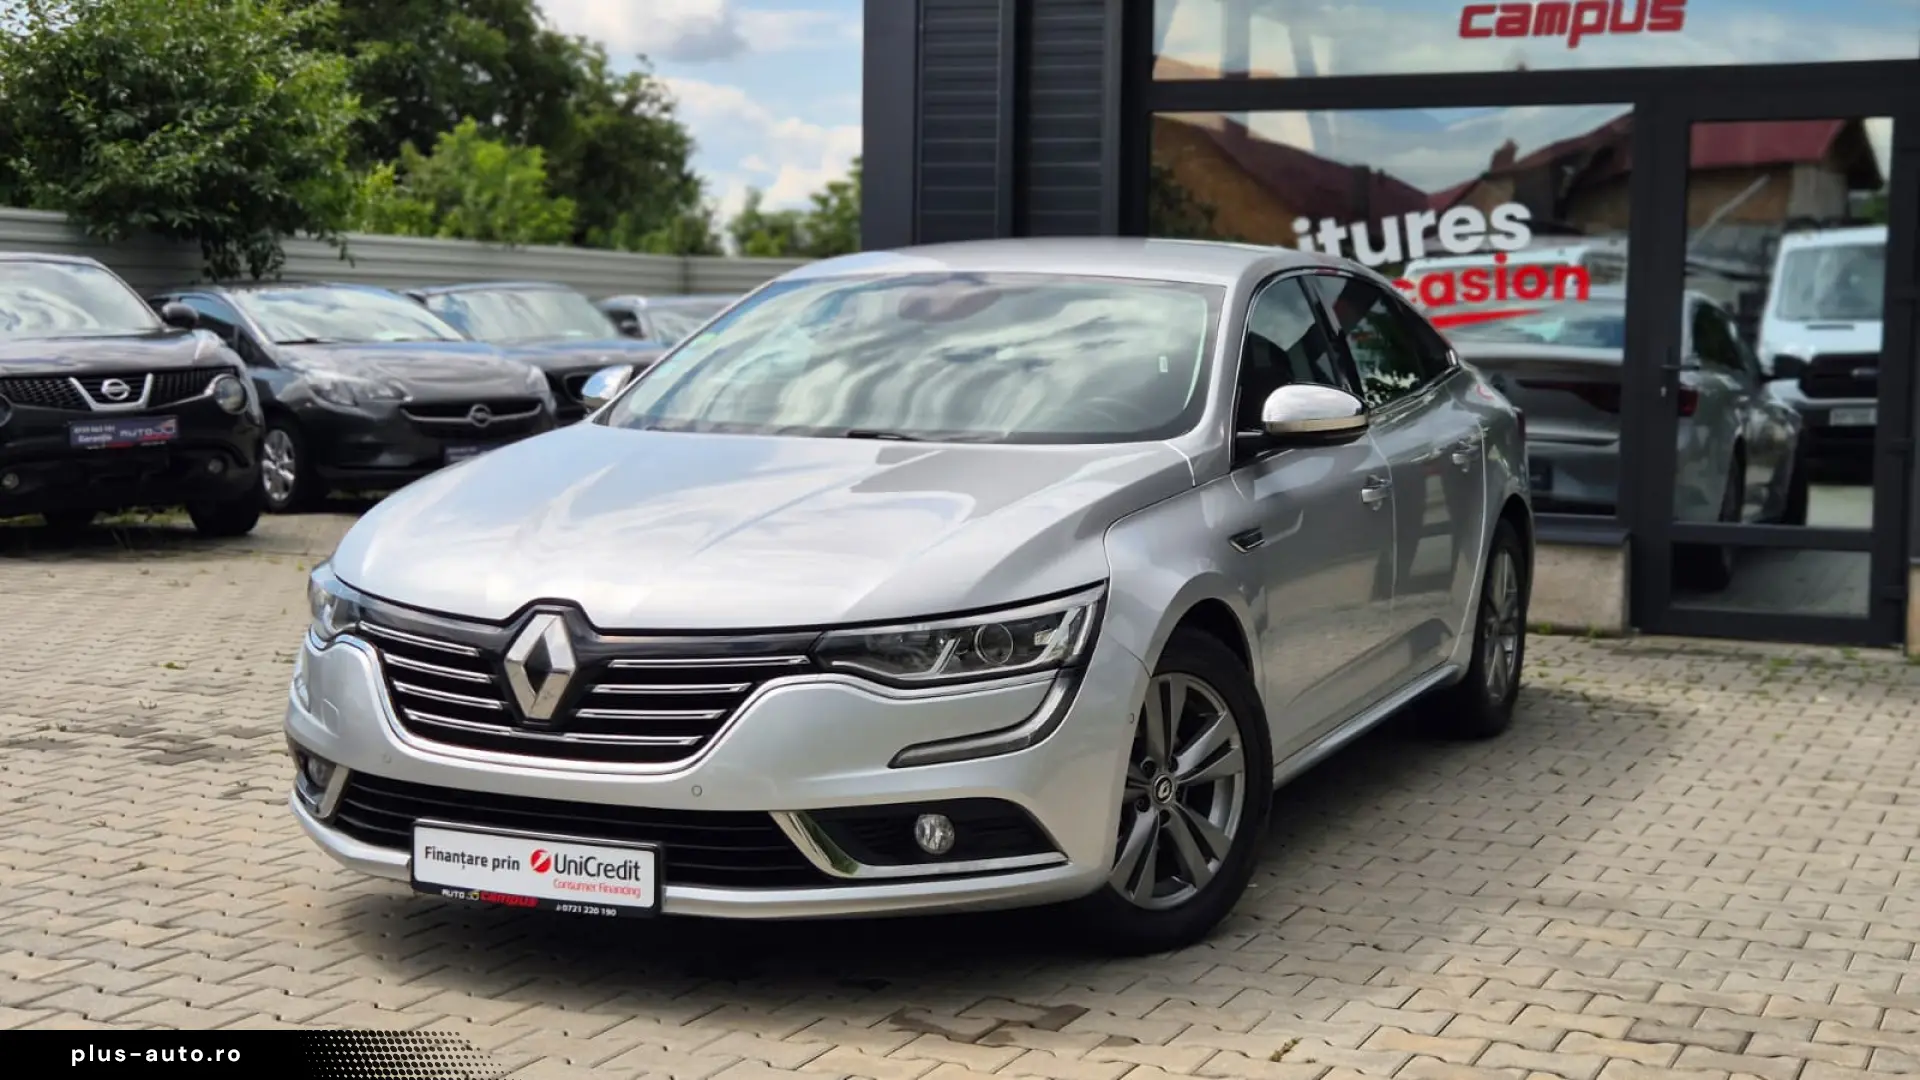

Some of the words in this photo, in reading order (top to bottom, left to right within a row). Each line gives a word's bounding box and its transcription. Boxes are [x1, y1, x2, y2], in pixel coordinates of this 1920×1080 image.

[1459, 0, 1688, 49] campus
[424, 846, 488, 870] Finanțare
[492, 855, 520, 871] prin
[554, 852, 641, 882] UniCredit
[441, 888, 465, 899] AUTO
[553, 877, 596, 892] Consumer
[599, 883, 642, 899] Financing
[562, 904, 582, 913] 0721
